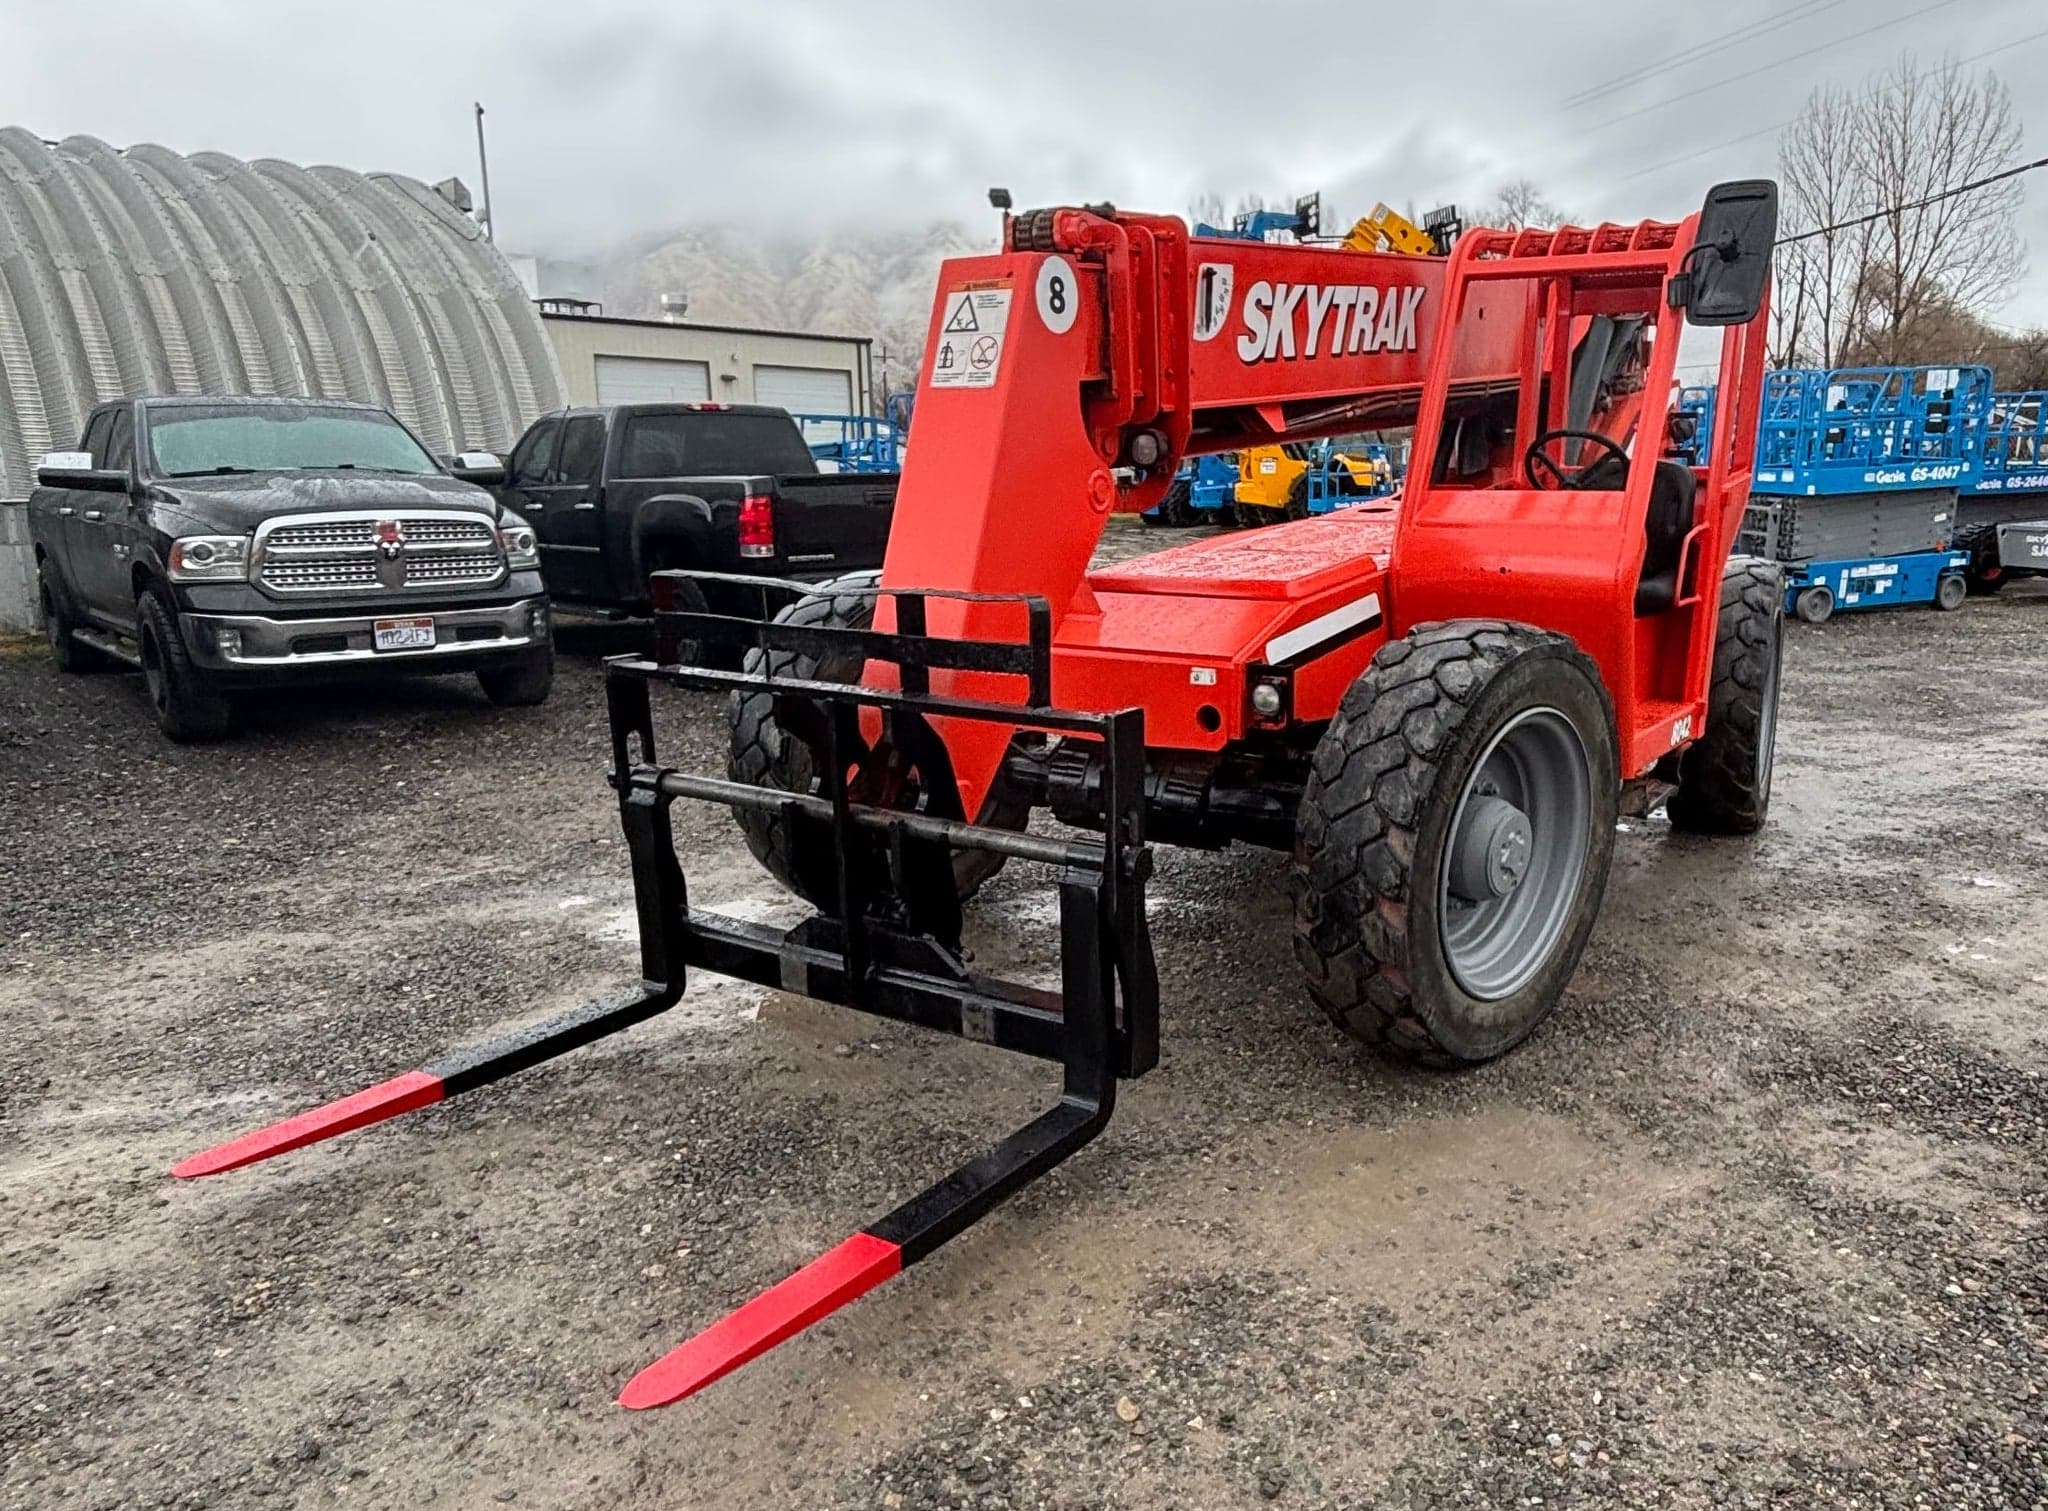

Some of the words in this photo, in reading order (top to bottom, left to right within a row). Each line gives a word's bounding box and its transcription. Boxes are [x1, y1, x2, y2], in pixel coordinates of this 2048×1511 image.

[1049, 275, 1066, 315] 8
[1237, 280, 1426, 363] SKYTRAK
[1875, 469, 1906, 484] Genie
[1910, 465, 1961, 482] GS-4047
